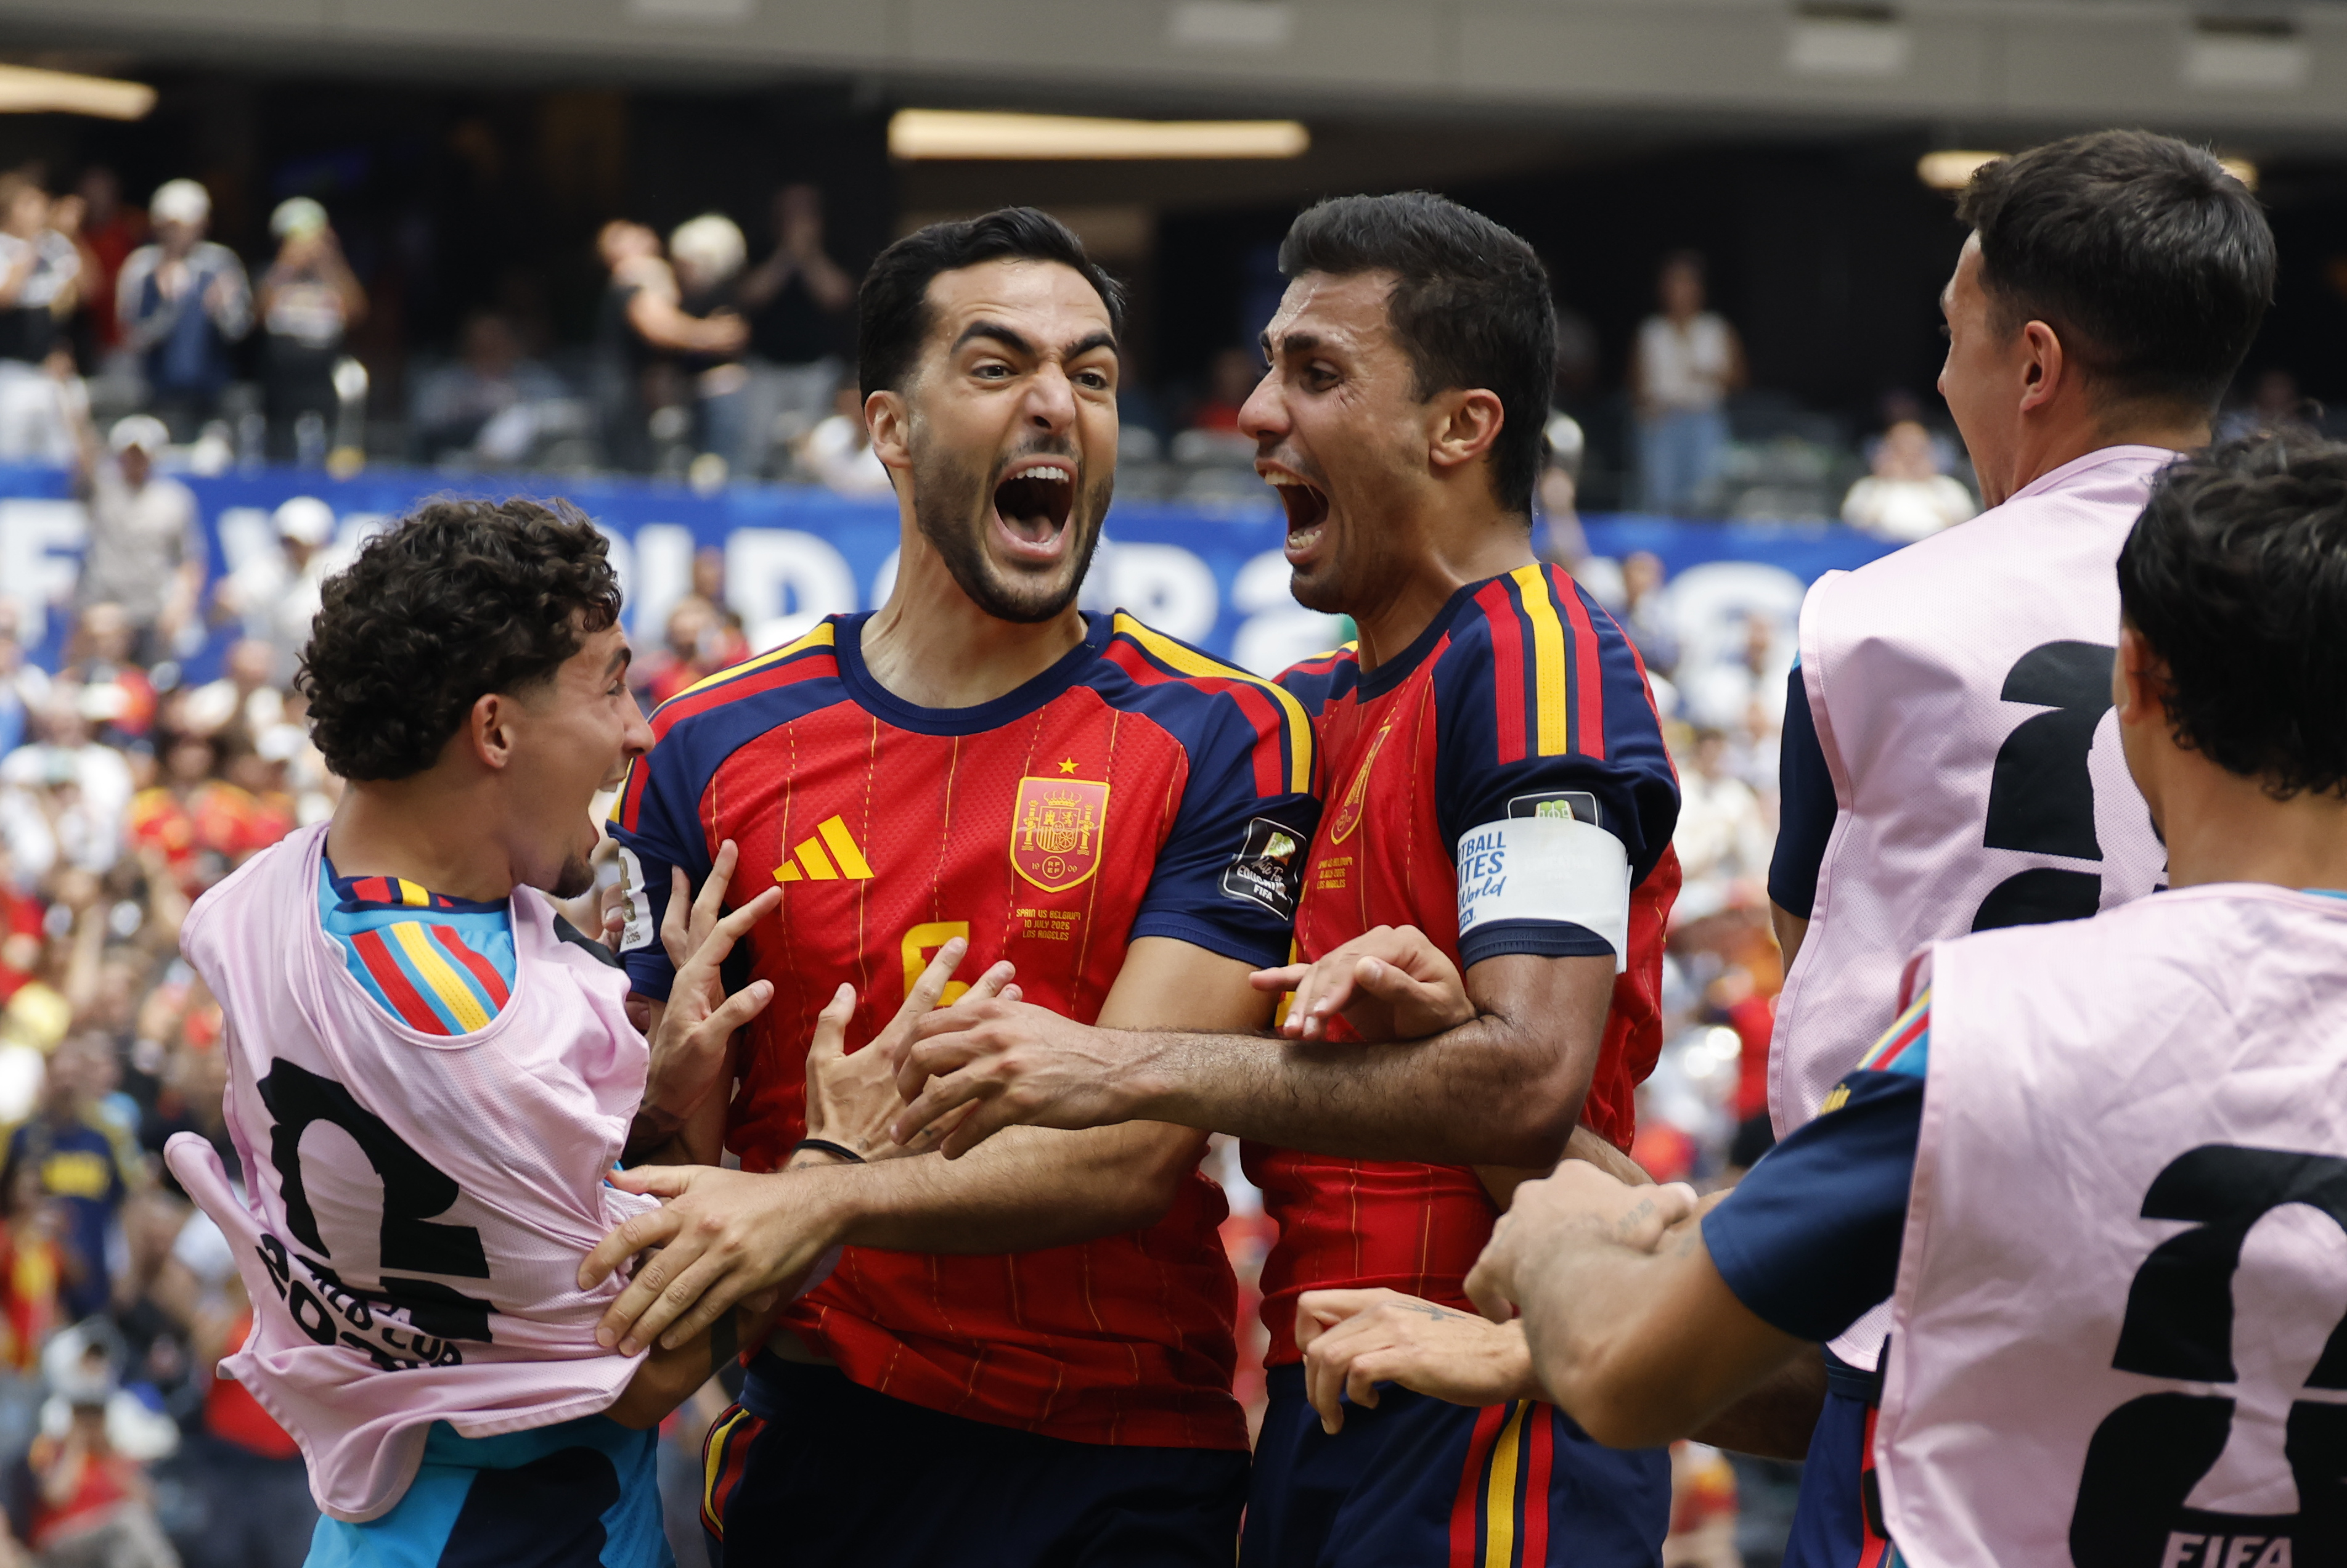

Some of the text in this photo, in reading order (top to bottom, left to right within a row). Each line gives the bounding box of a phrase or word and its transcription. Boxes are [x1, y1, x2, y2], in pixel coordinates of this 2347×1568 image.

[1458, 831, 1506, 864] TBALL
[1457, 851, 1504, 890] ITES
[1254, 884, 1273, 902] FIFA
[1016, 909, 1035, 918] SPAIN
[1049, 910, 1080, 921] BELGIUM
[1024, 919, 1070, 930] 10 JULY 2026
[1023, 929, 1069, 941] LOS ANGELES
[2161, 1531, 2294, 1568] FIFA
